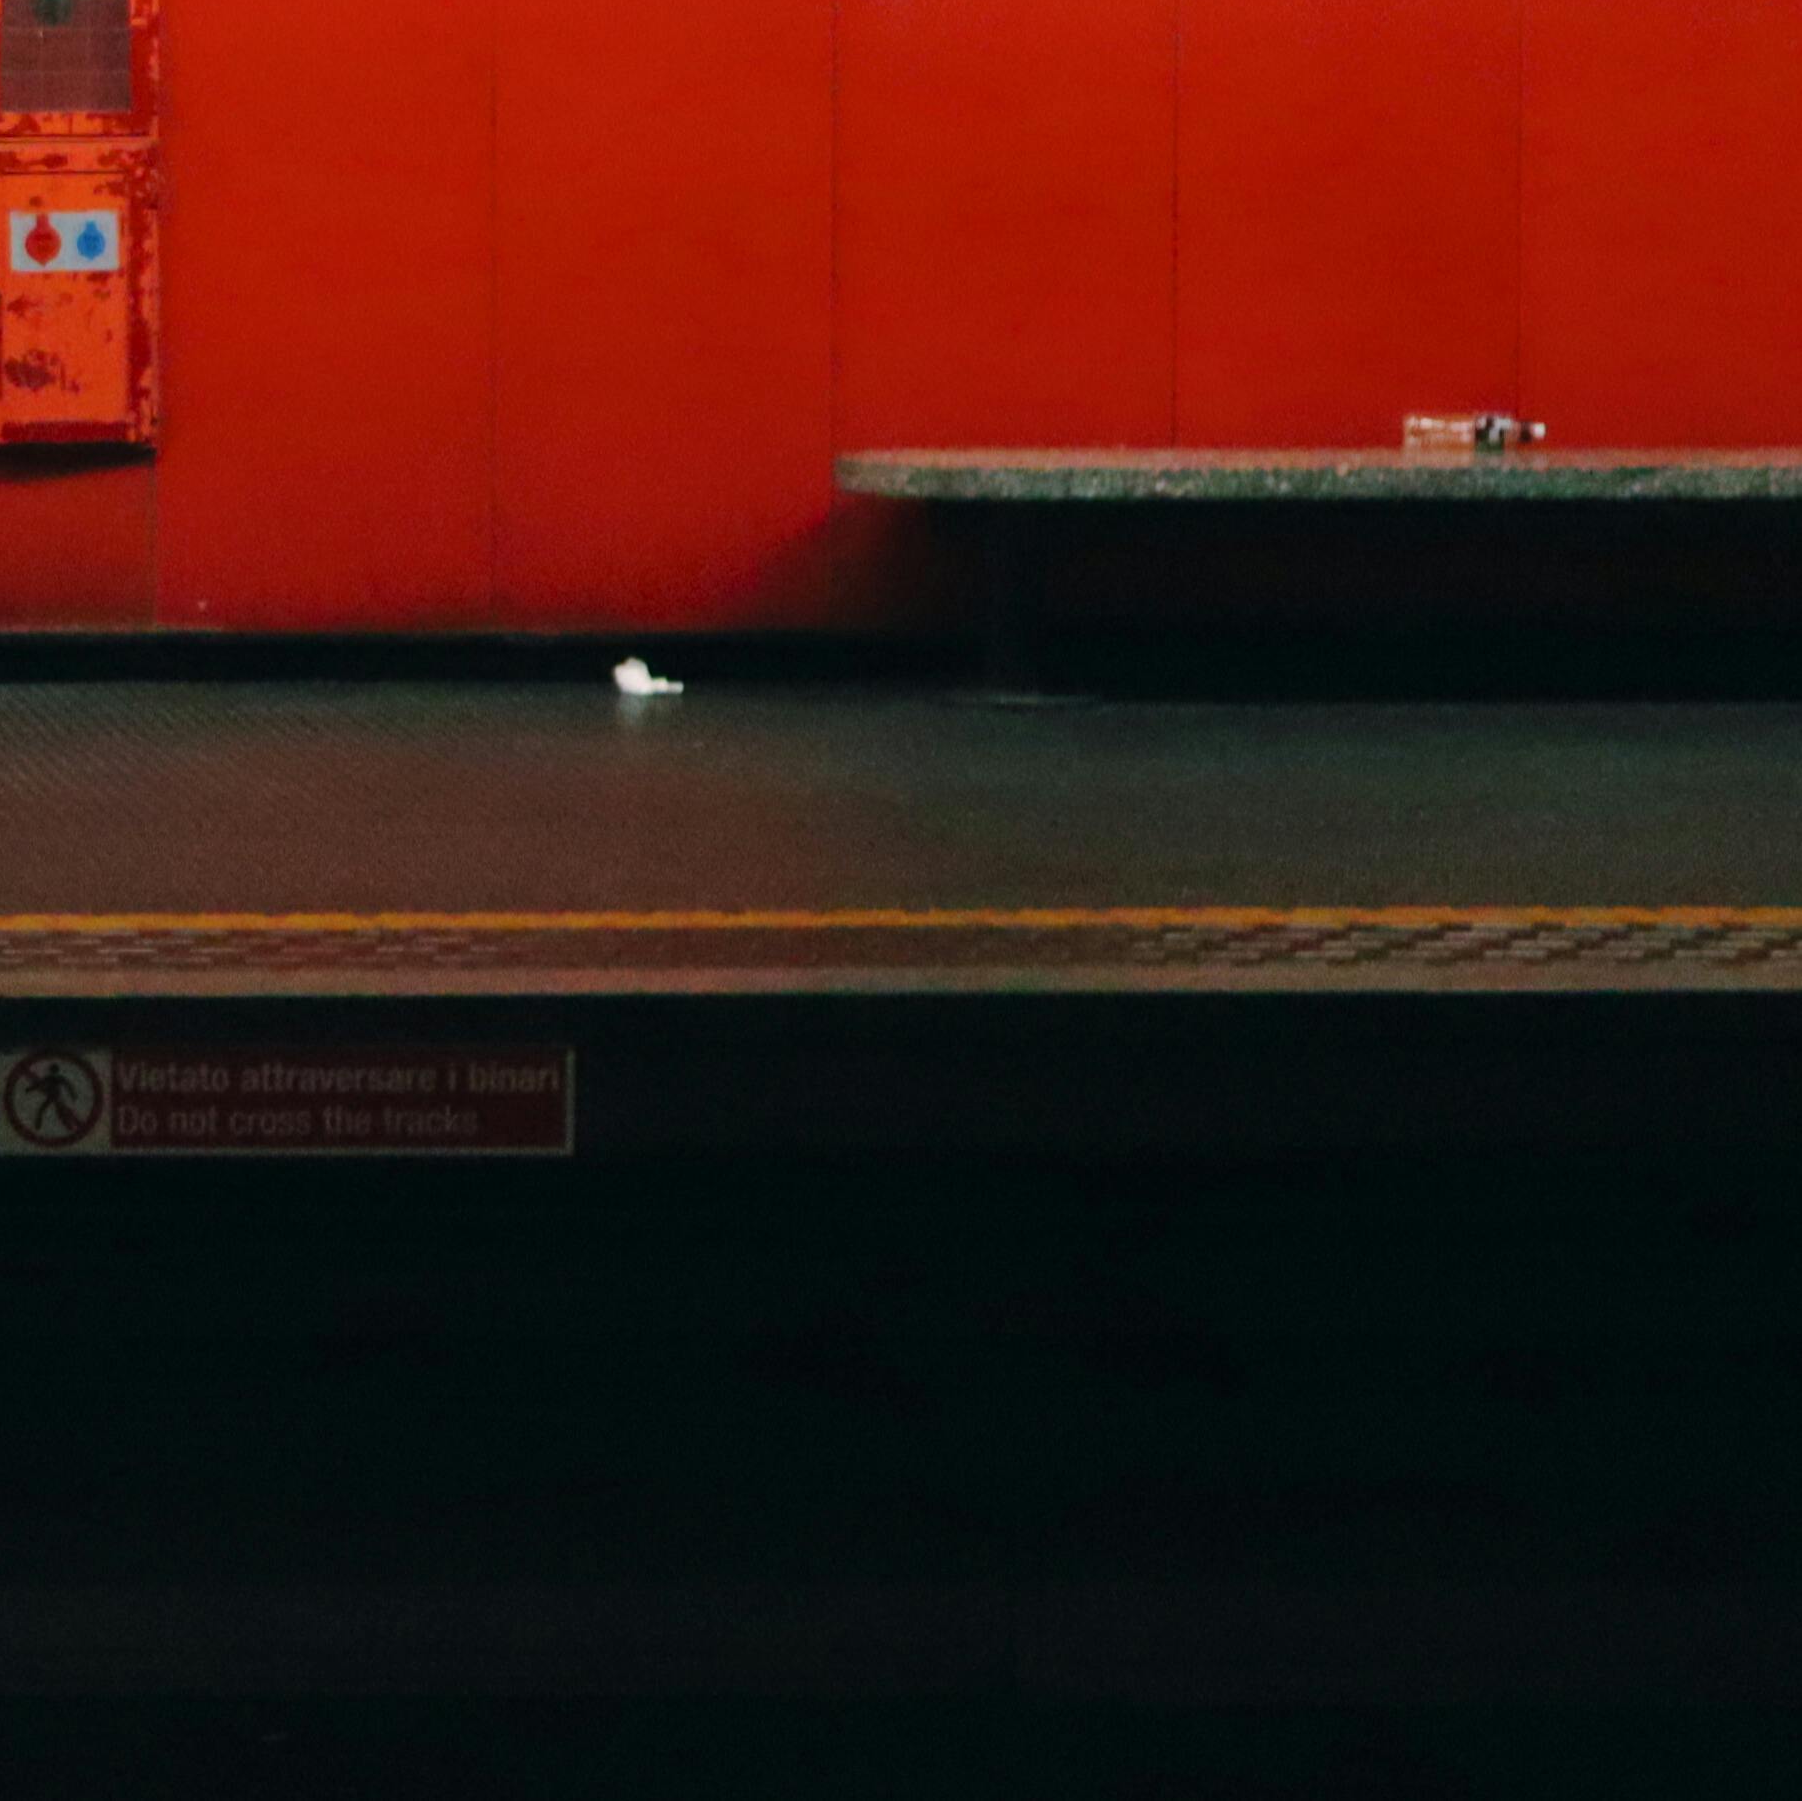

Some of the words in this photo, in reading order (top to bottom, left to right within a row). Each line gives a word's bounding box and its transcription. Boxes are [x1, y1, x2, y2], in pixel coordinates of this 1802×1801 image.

[116, 1061, 230, 1093] Vietato
[241, 1061, 437, 1093] attraversare
[468, 1061, 559, 1093] binari
[117, 1105, 159, 1136] Do
[170, 1106, 218, 1136] not
[228, 1111, 312, 1136] cross
[323, 1105, 373, 1136] the
[383, 1105, 478, 1136] tracks
